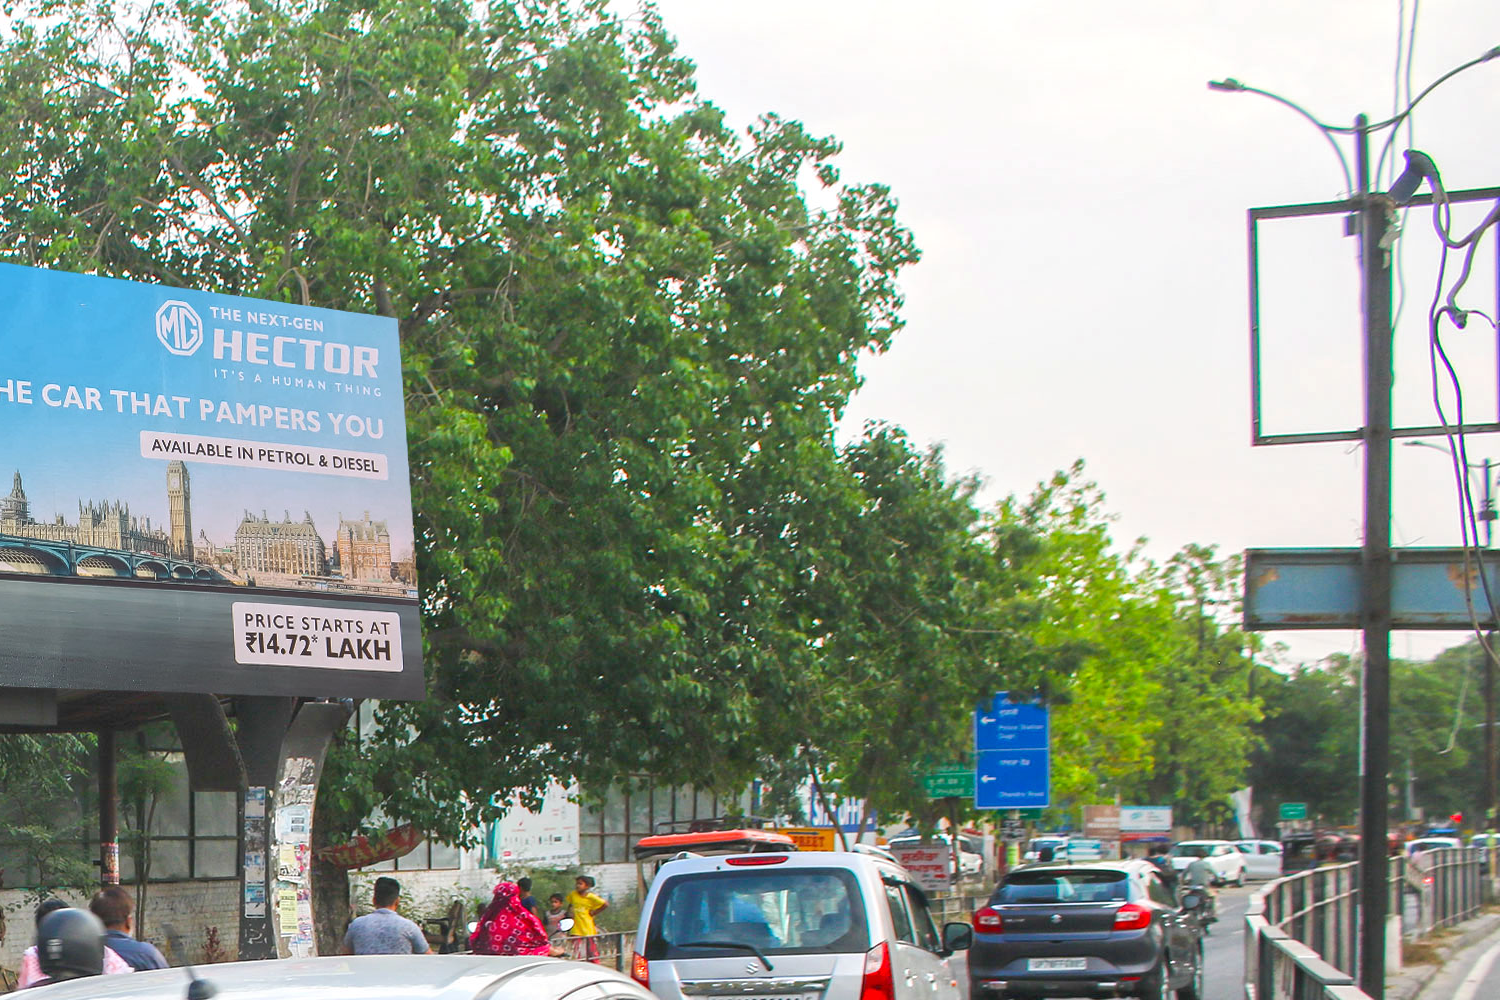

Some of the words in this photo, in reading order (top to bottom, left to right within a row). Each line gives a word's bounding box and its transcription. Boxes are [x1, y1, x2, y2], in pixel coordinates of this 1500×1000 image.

[159, 304, 200, 352] MG
[209, 306, 242, 323] THE
[247, 311, 324, 332] NEXT-GEN
[213, 328, 379, 379] HECTOR
[214, 368, 245, 381] IT'S
[254, 374, 262, 384] A
[272, 375, 327, 391] HUMAN
[335, 382, 382, 398] THING
[41, 383, 103, 411] CAR
[109, 389, 191, 419] THAT
[199, 398, 321, 433] PAMPERS
[327, 412, 384, 440] YOU
[151, 438, 233, 459] AVAILABLE
[237, 446, 254, 461] IN
[258, 448, 315, 467] PETROL
[318, 454, 329, 468] &
[332, 455, 380, 474] DIESEL
[244, 613, 295, 630] PRICE
[301, 616, 364, 634] STARTS
[369, 621, 391, 636] AT
[325, 636, 392, 661] LAKH
